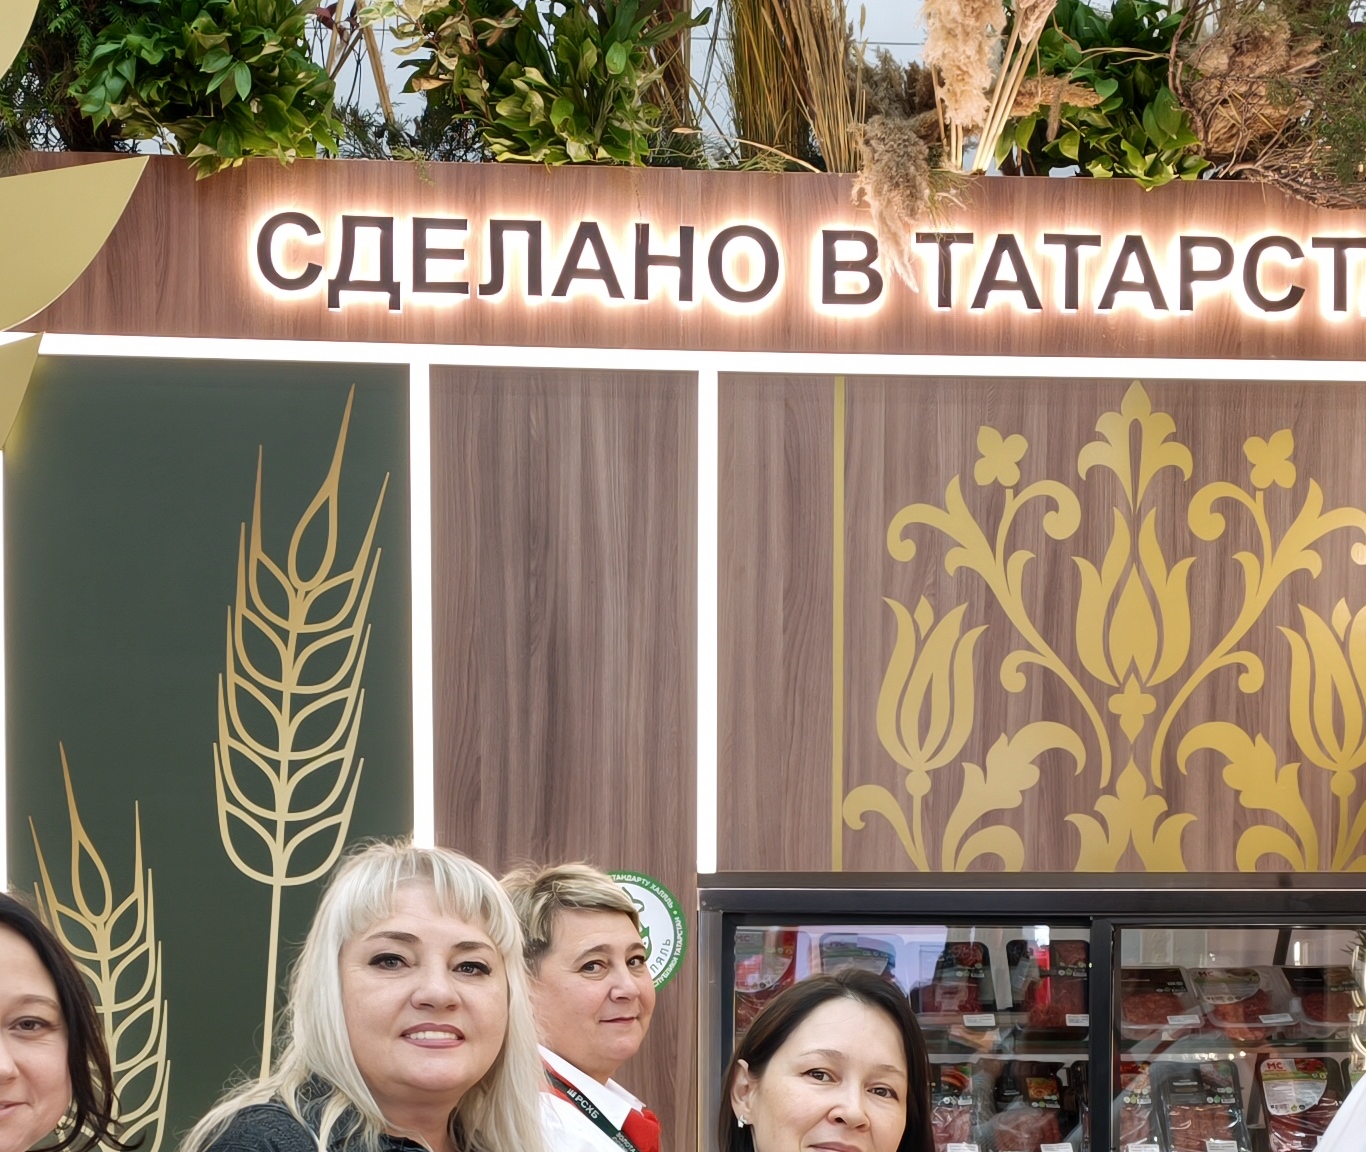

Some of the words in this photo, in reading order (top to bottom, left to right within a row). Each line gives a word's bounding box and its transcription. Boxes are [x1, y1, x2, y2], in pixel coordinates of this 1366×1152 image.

[256, 211, 780, 311] СДЕЛАНО
[821, 229, 884, 305] В
[610, 874, 650, 887] ТАНДАРТУ
[575, 1094, 600, 1119] РСХБ
